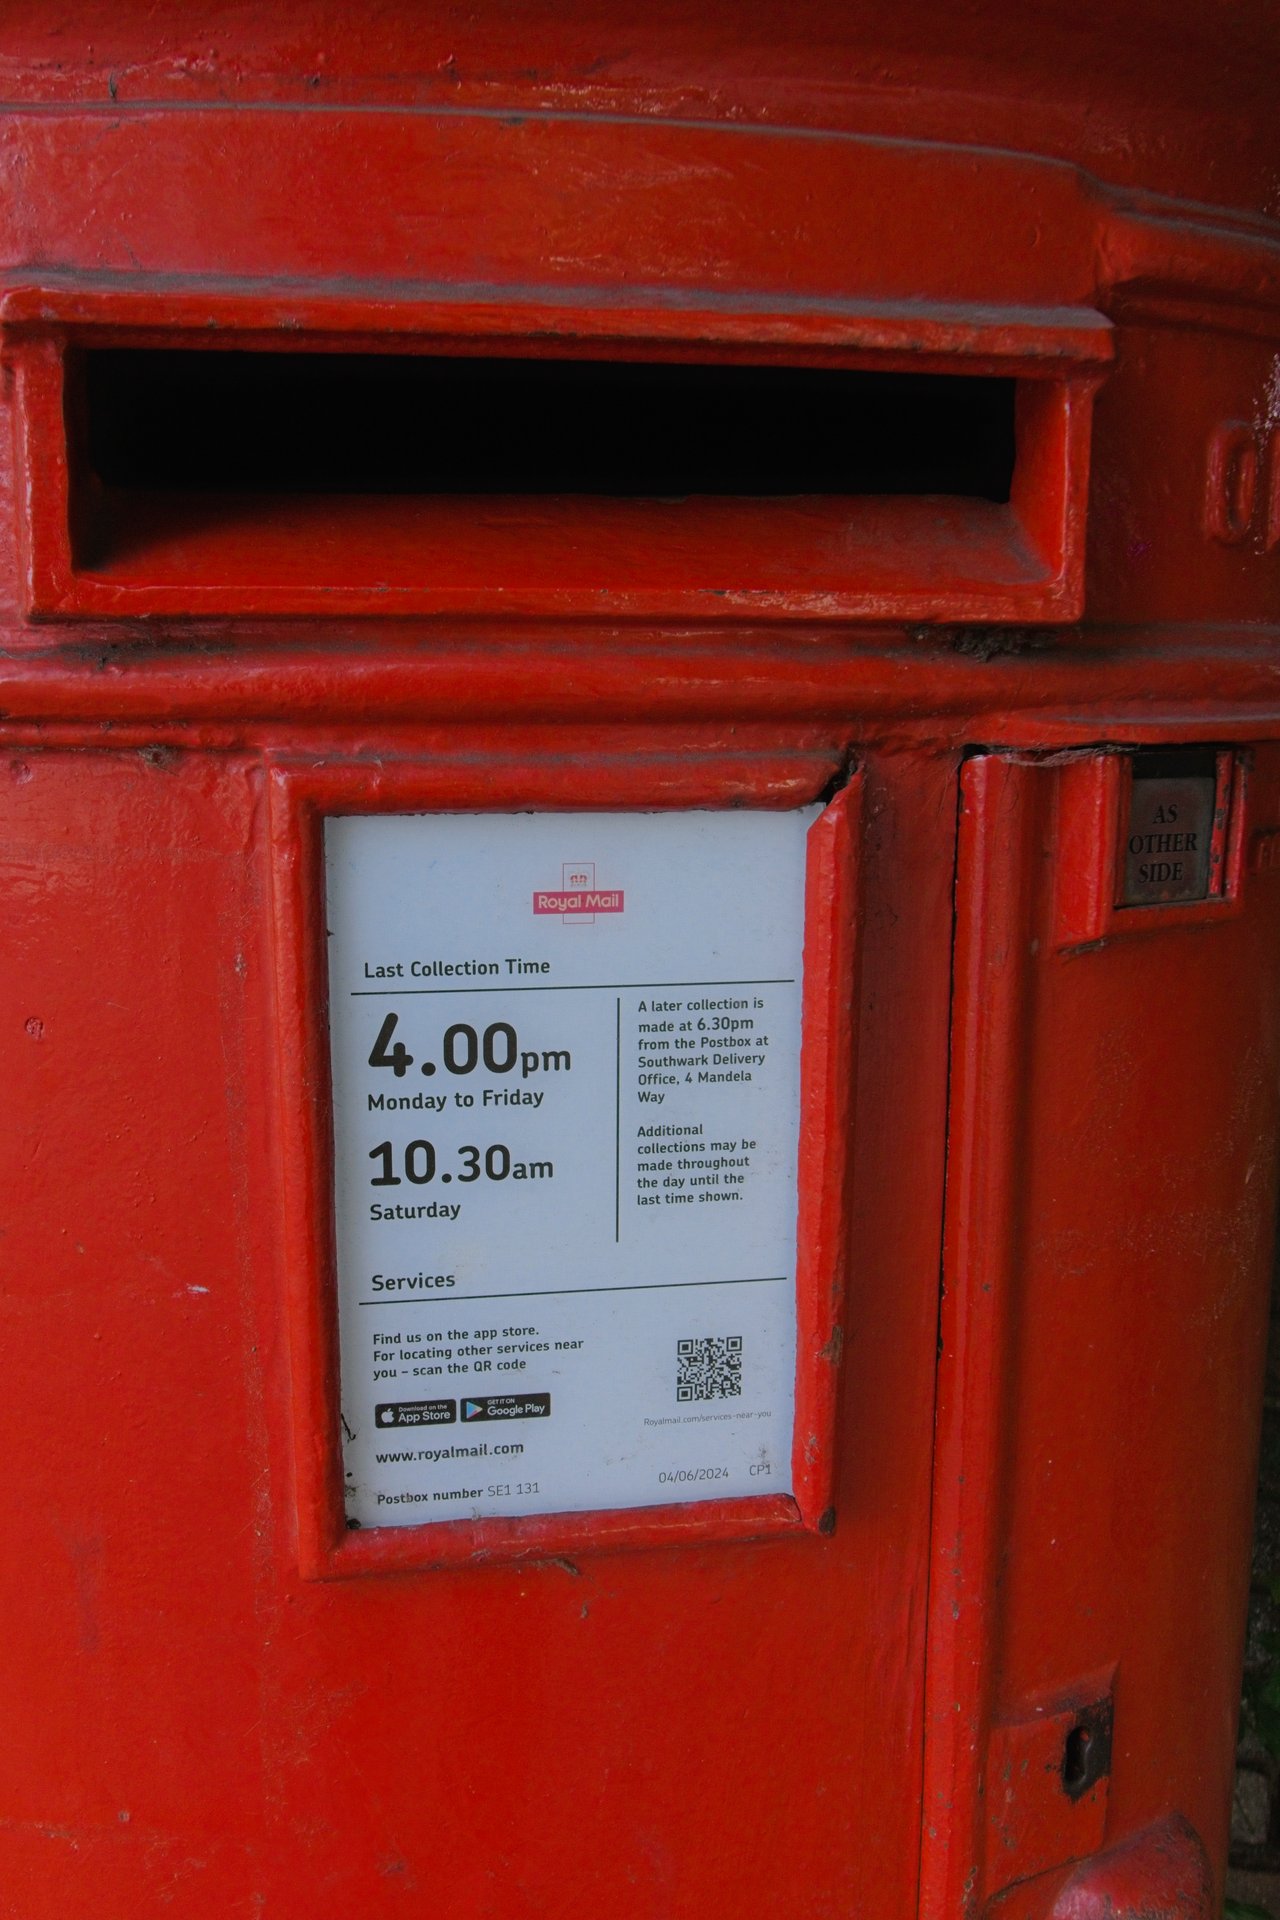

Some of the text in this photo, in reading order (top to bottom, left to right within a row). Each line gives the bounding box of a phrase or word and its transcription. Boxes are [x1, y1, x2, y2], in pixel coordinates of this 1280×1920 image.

[1153, 804, 1178, 823] AS
[1129, 833, 1197, 854] OTHER
[1138, 863, 1183, 883] SIDE
[538, 893, 620, 910] Royal Mail
[365, 958, 550, 978] Last Collection Time
[638, 997, 763, 1012] A later collection is
[639, 1016, 753, 1032] made at 6.30pm
[639, 1035, 768, 1050] from the Postbox at
[638, 1052, 765, 1068] Southwark Delivery
[639, 1070, 751, 1086] Office, 4 Mandela
[368, 1089, 544, 1112] Monday to Friday
[638, 1091, 665, 1104] Way
[638, 1123, 702, 1137] Additional
[638, 1138, 756, 1154] collections may be
[638, 1156, 749, 1171] made throughout
[637, 1172, 744, 1188] the day until the
[638, 1191, 742, 1205] last time shown.
[370, 1201, 460, 1220] Saturday
[372, 1272, 455, 1291] Services
[374, 1326, 539, 1345] Find us on the app store.
[374, 1340, 584, 1361] For locating other services near
[374, 1369, 396, 1381] you
[413, 1366, 442, 1376] scan
[448, 1362, 468, 1373] the
[474, 1360, 491, 1372] QR
[497, 1358, 526, 1370] code
[398, 1409, 451, 1423] App Store
[399, 1404, 428, 1412] Download
[487, 1402, 546, 1417] Google Play
[643, 1410, 772, 1427] Royalmail.com/services-near-you
[376, 1444, 523, 1463] www.royalmail.com
[659, 1466, 729, 1483] 04/06/2024
[749, 1463, 772, 1476] CP1
[377, 1481, 539, 1505] Postbox number SE1 131
